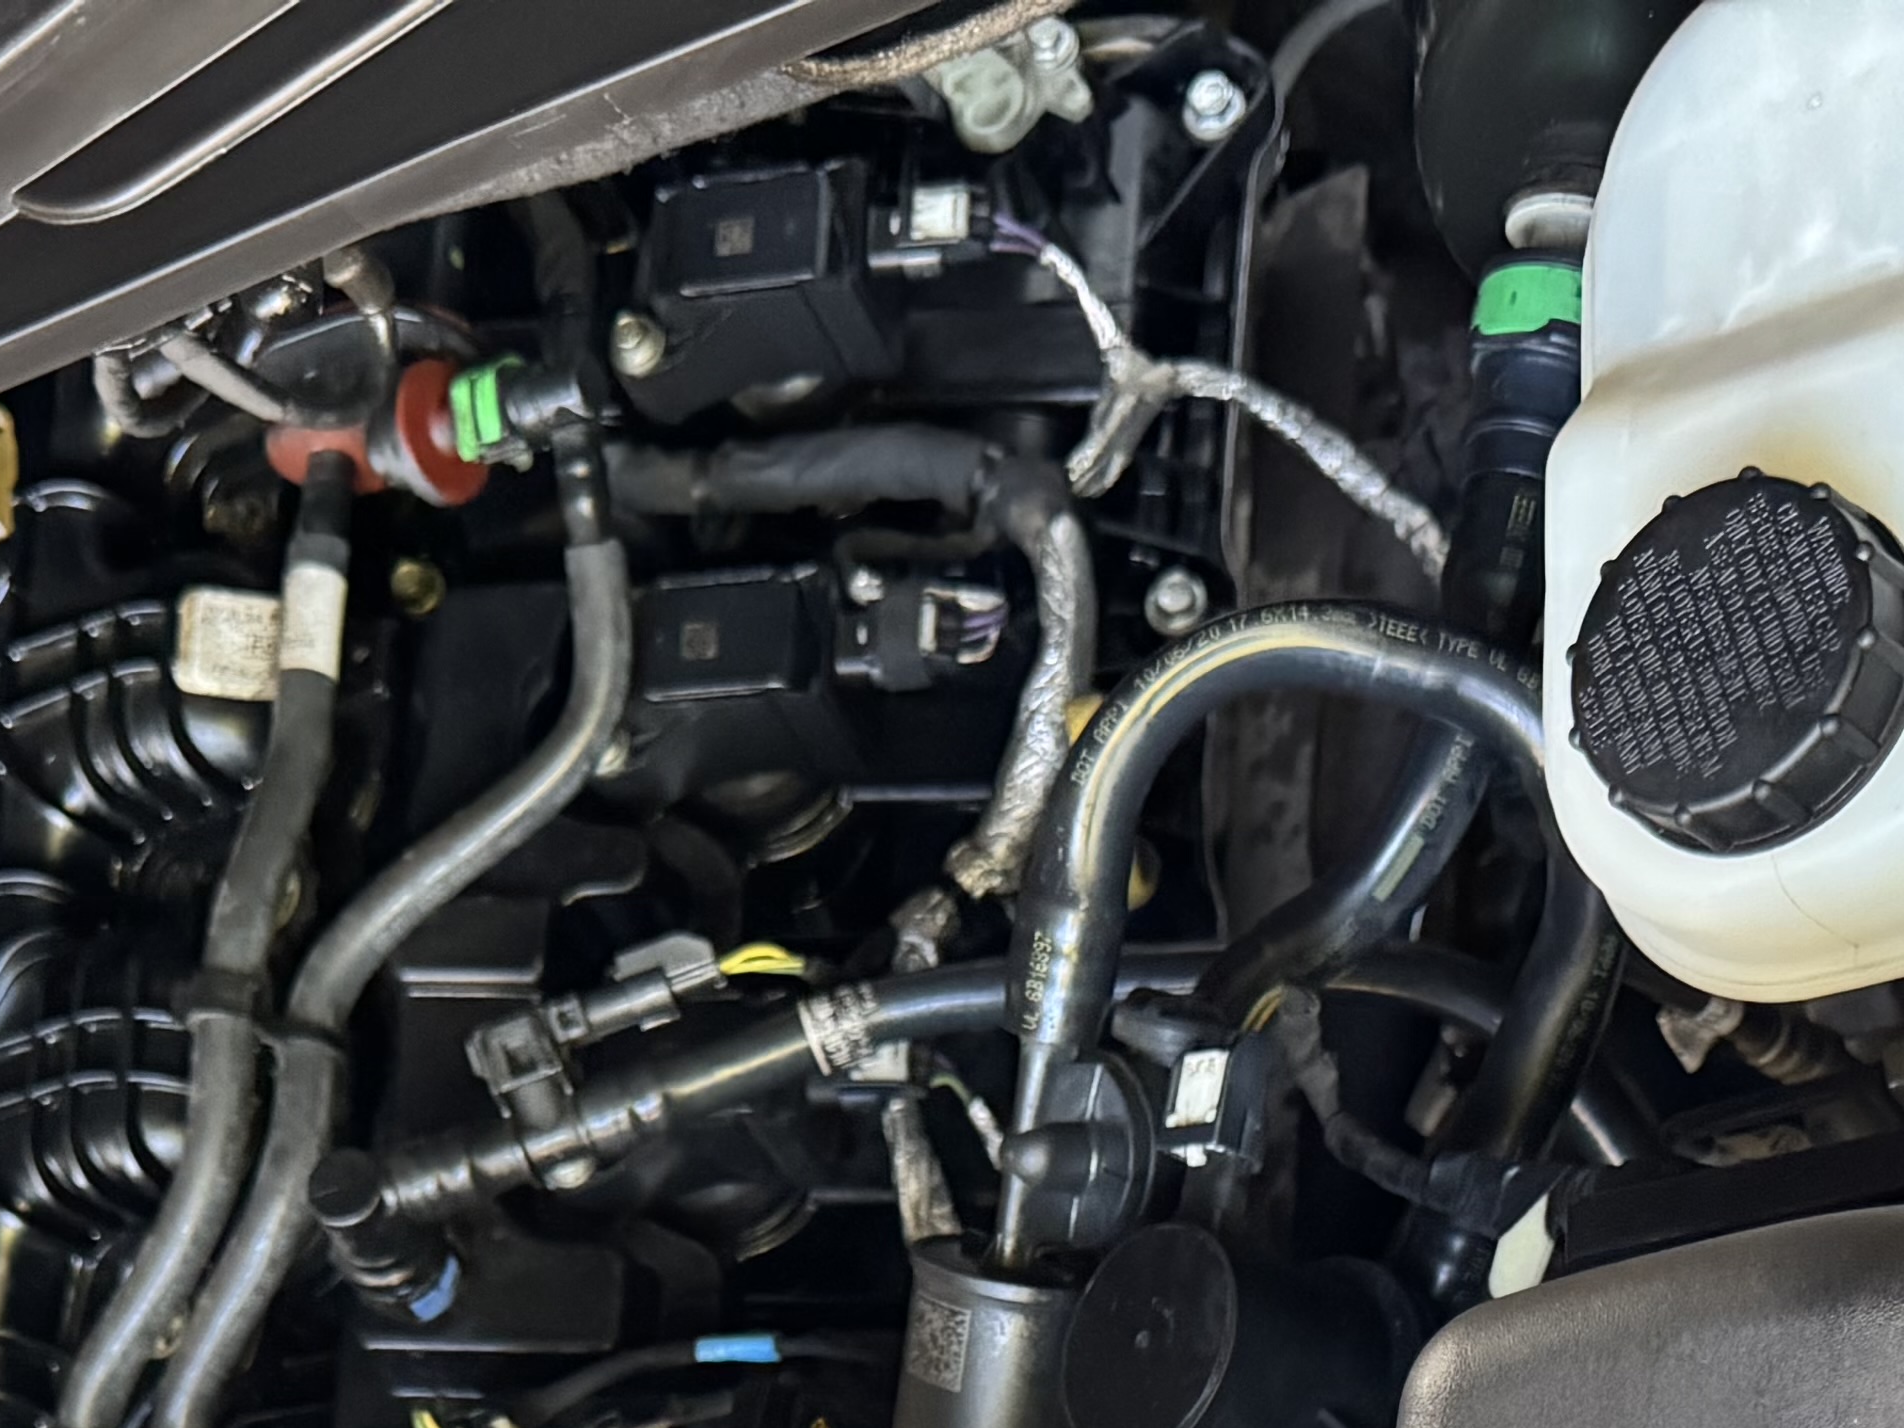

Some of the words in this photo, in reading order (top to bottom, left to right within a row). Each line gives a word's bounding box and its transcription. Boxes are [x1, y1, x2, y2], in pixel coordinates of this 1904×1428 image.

[1725, 507, 1753, 554] ONLY
[1632, 548, 1666, 604] AVANT
[1707, 543, 1745, 612] SEALED
[1738, 552, 1767, 591] DOT
[1775, 501, 1809, 560] CLEAN
[1792, 556, 1828, 619] FILLER
[1812, 615, 1842, 653] CAP
[1604, 616, 1629, 653] DOT
[1659, 549, 1702, 643] NETTOYER
[1695, 661, 1738, 750] BOUCHON
[1753, 602, 1787, 656] FLUID
[1638, 644, 1665, 684] QUE
[1771, 652, 1805, 710] FROM
[1650, 680, 1673, 710] DU
